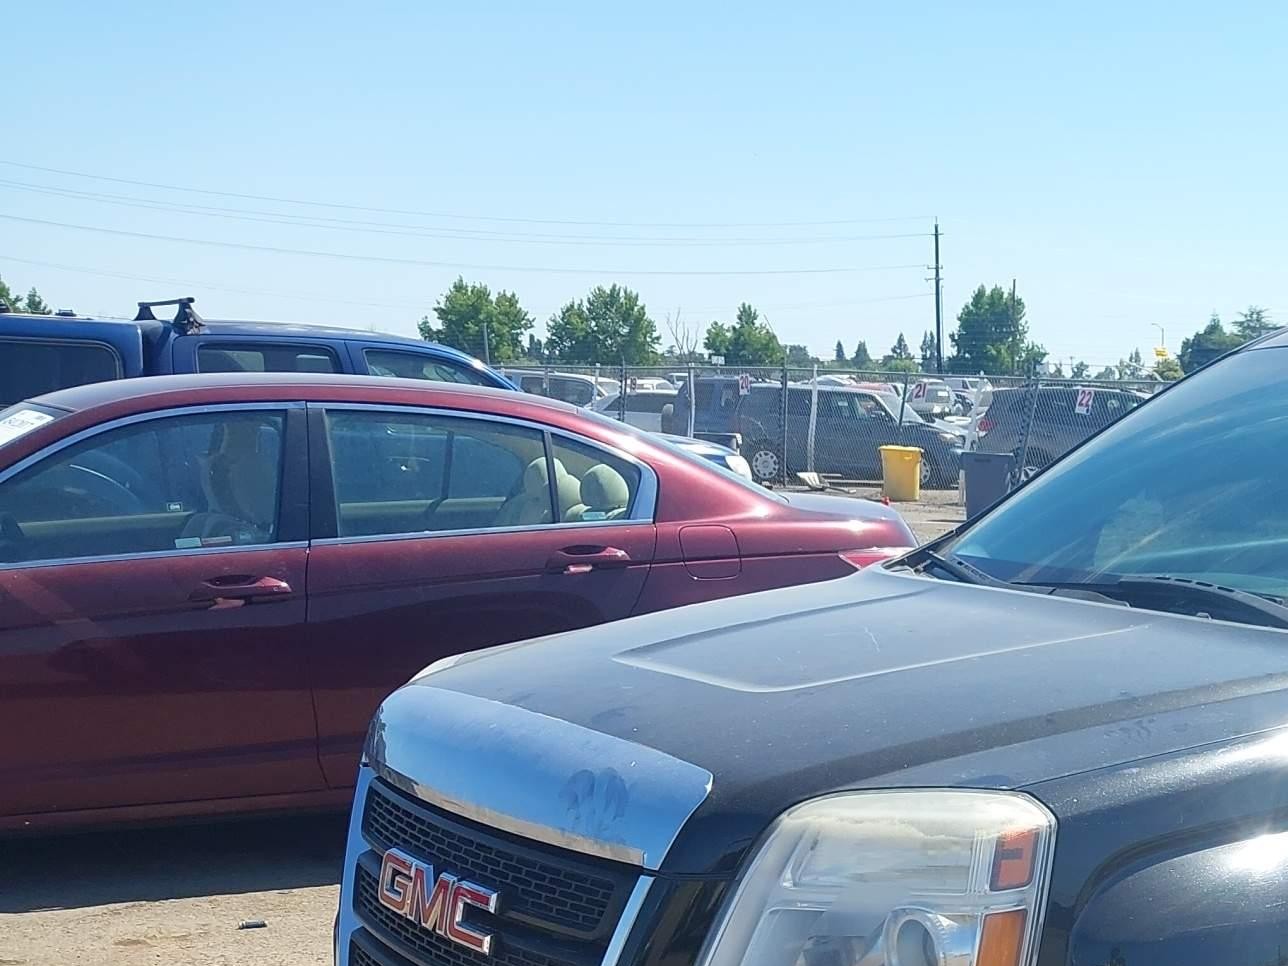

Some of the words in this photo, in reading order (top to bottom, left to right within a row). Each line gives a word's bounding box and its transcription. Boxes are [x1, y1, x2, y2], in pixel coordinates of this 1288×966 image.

[740, 375, 749, 389] 20
[914, 383, 926, 398] 21
[1078, 390, 1093, 408] 22
[378, 847, 499, 956] GMC
